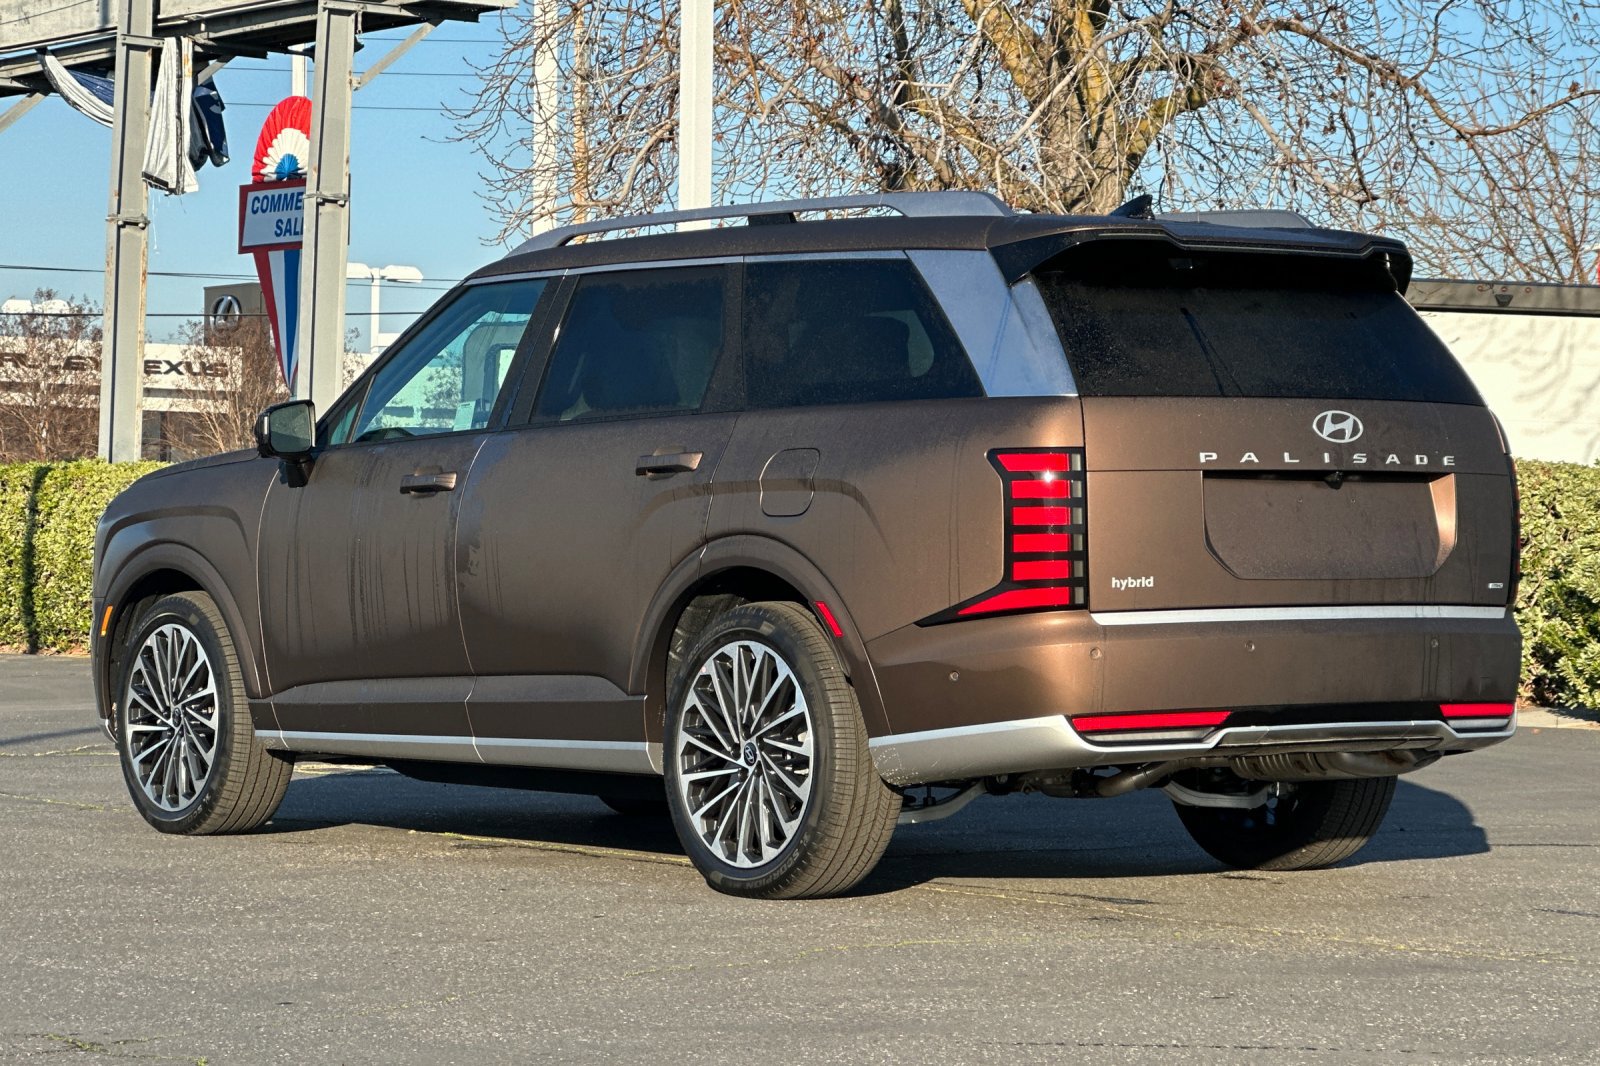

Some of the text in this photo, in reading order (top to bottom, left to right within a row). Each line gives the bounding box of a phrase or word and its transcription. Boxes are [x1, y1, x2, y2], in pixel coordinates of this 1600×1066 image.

[251, 192, 304, 215] COMME
[143, 359, 229, 378] EXUS
[1199, 452, 1455, 466] PALISADE
[1111, 576, 1154, 591] hybrid
